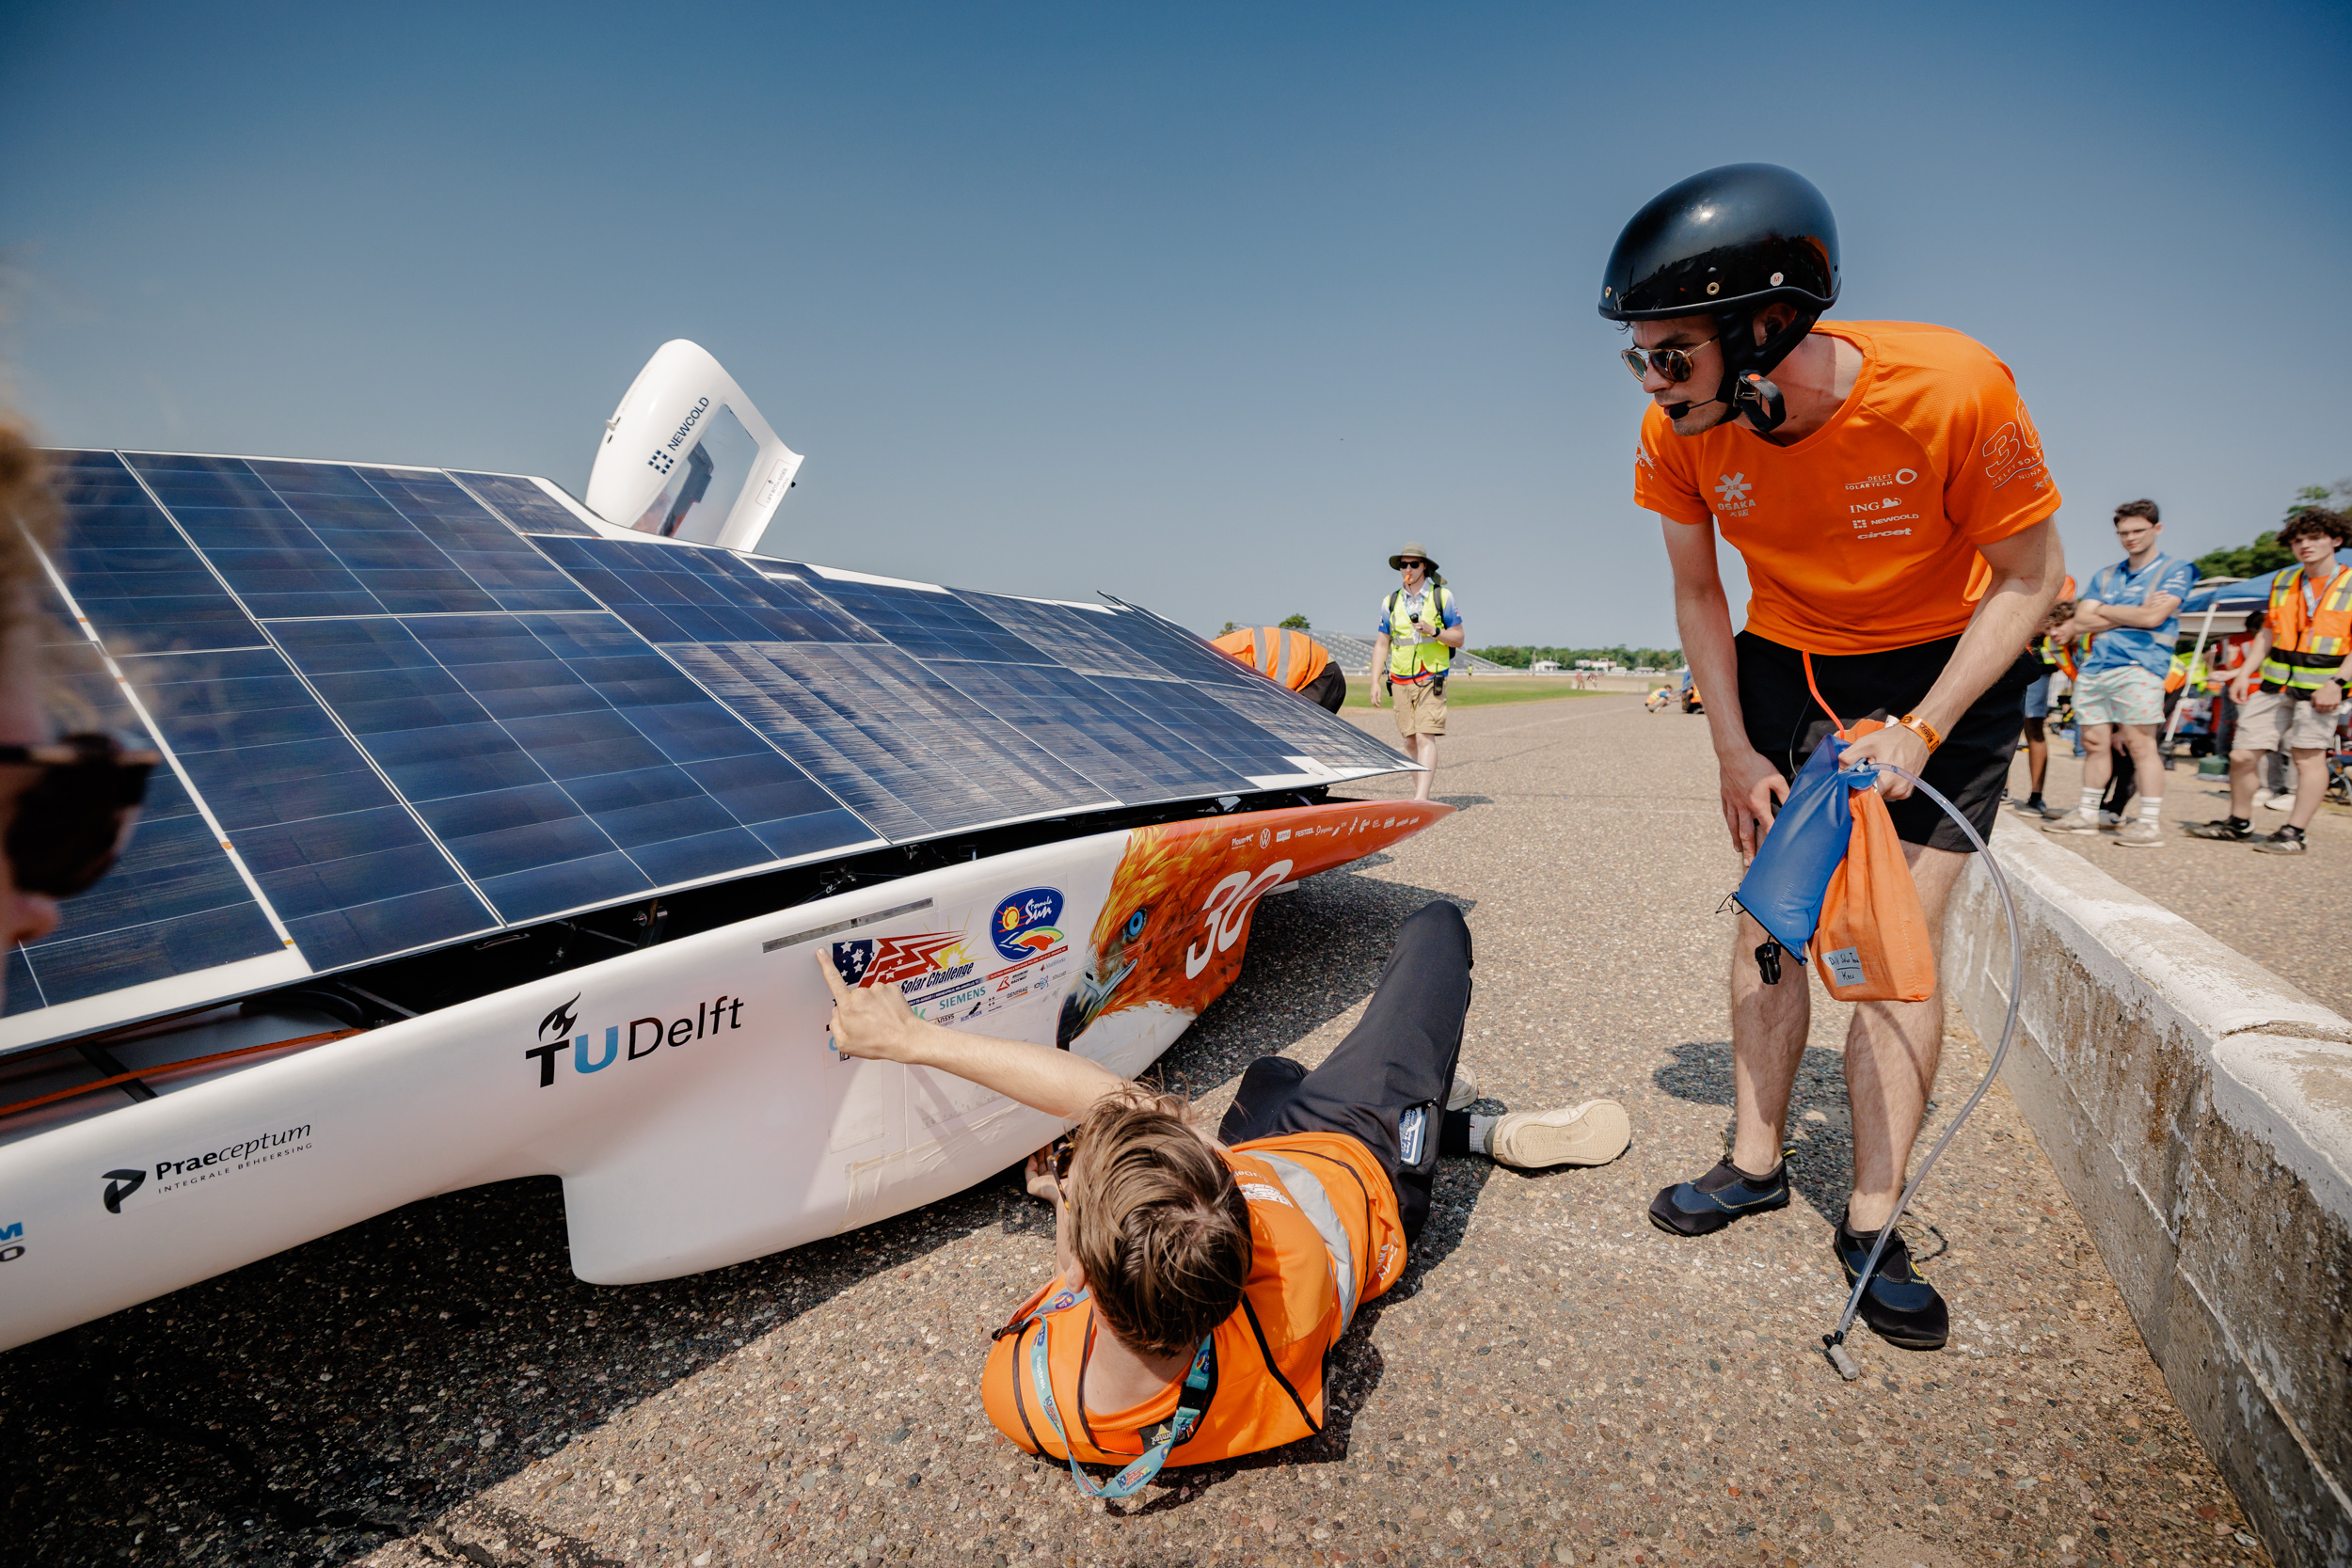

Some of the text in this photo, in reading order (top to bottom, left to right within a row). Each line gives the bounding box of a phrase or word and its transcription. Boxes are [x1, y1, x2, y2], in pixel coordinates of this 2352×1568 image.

[667, 396, 709, 451] NEWCOLD
[1993, 465, 2016, 485] DELFT
[2018, 468, 2042, 480] NUNA
[1717, 499, 1756, 511] OSAKA
[1850, 501, 1880, 514] ING
[1870, 514, 1919, 525] NEWCOLD
[1857, 528, 1912, 539] circet
[1185, 859, 1294, 980] 30
[901, 962, 975, 994] Solar Challenge
[939, 986, 986, 1010] SIEMENS
[1006, 986, 1028, 998] GENERAC
[156, 1124, 311, 1180] Praeceptum
[158, 1143, 312, 1194] INTEGRALE BEHEERSING
[1036, 1355, 1046, 1390] electrek
[1151, 1432, 1172, 1443] orntex
